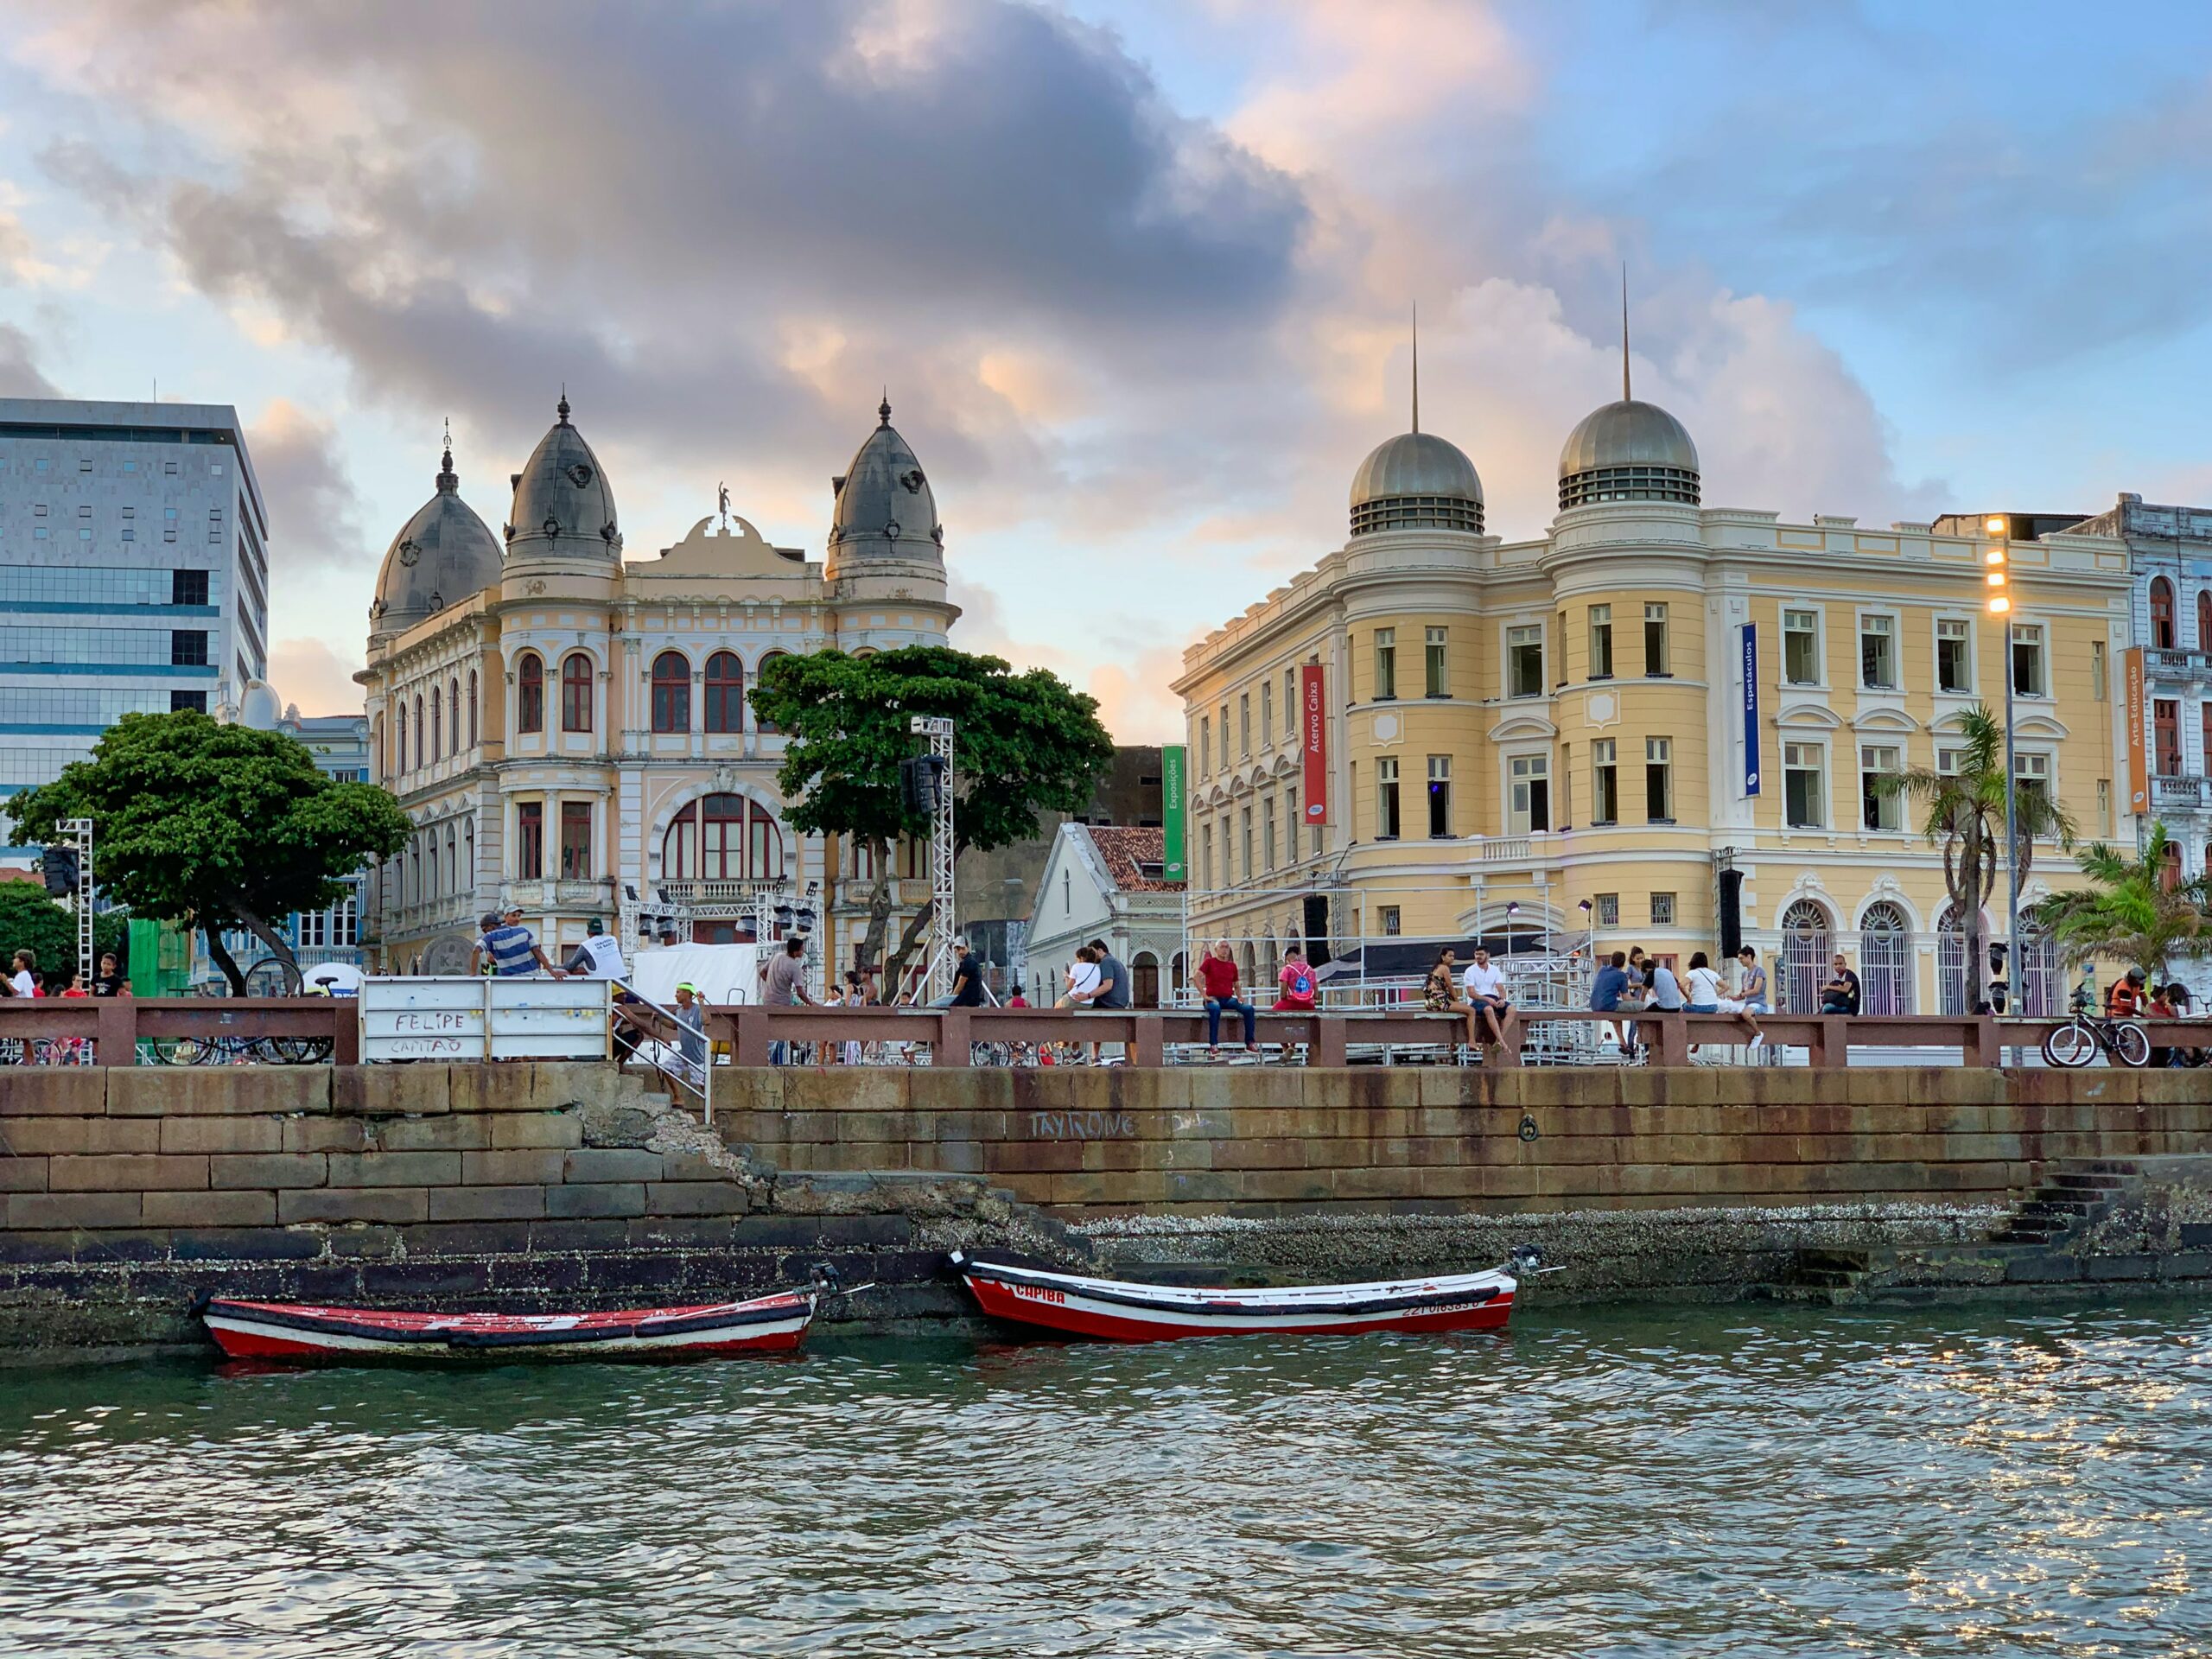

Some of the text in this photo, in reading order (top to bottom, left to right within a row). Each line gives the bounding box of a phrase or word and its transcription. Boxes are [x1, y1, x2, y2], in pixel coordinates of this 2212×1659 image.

[1745, 642, 1754, 710] Espetáculos
[2130, 666, 2139, 747] Arte-Educação
[1308, 682, 1319, 753] Acervo Caixa
[1168, 760, 1178, 810] Exposições
[1016, 1284, 1065, 1305] CAPIBA
